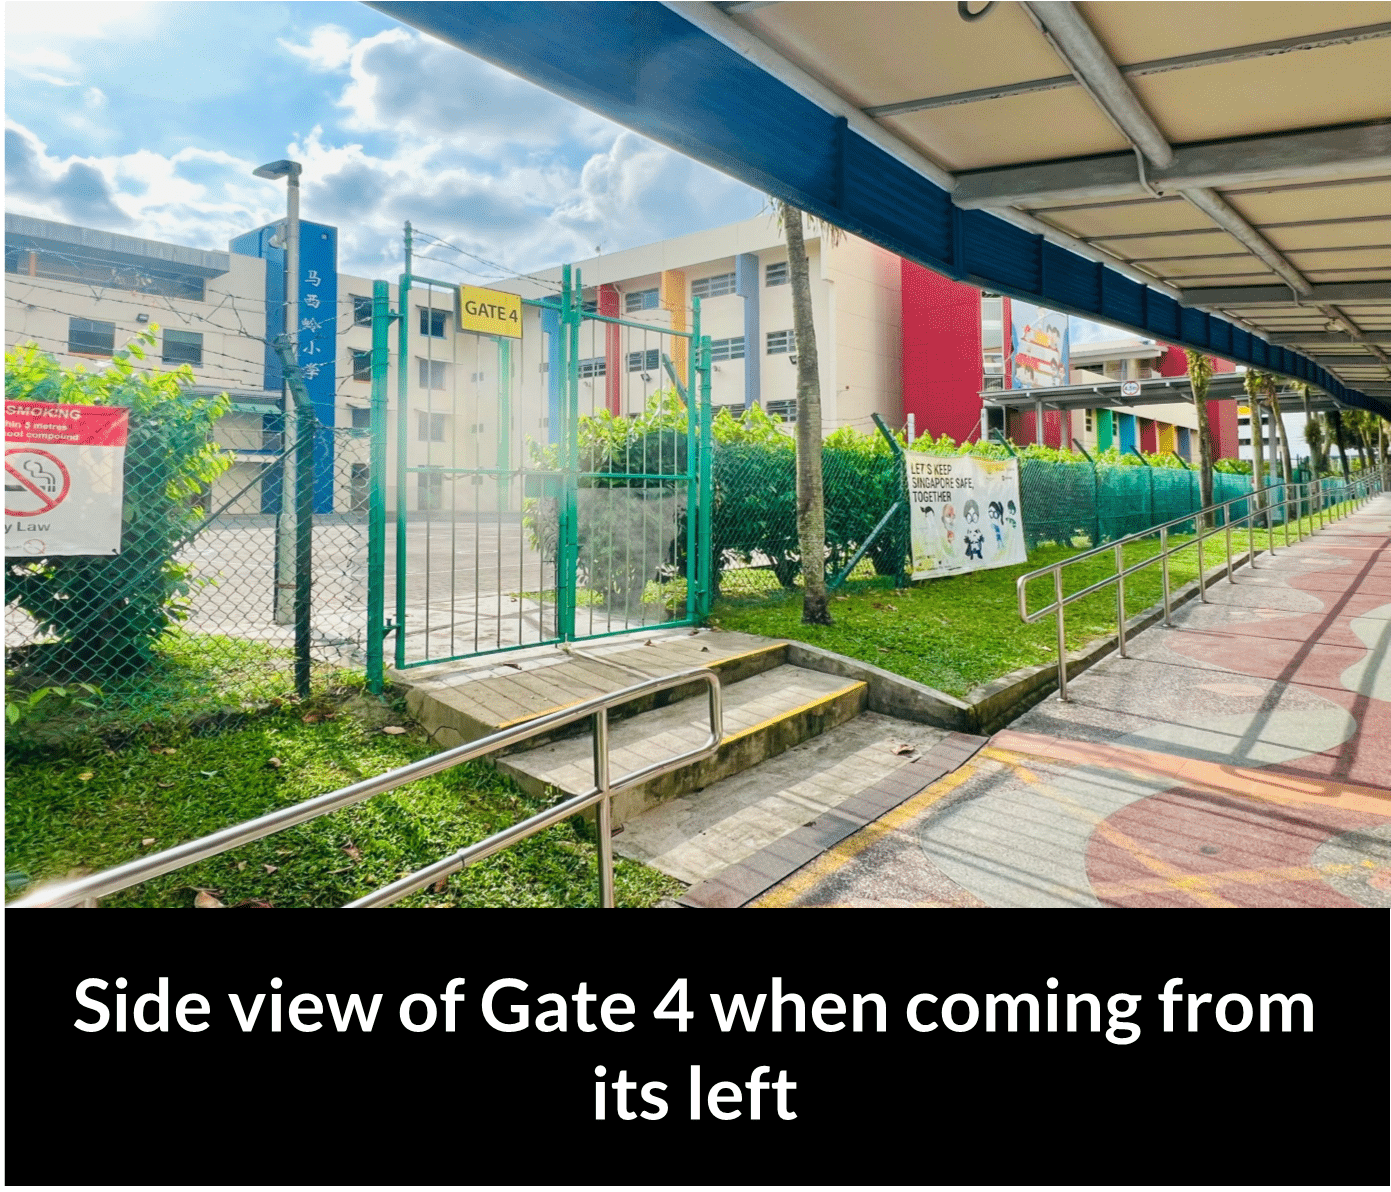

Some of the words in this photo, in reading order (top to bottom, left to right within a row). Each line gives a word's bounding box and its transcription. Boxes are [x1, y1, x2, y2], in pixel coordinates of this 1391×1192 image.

[465, 300, 507, 321] GATE
[509, 309, 519, 323] 4
[934, 464, 952, 476] KEEP
[912, 477, 955, 489] SINGAPORE
[912, 491, 952, 503] TOGETHER
[17, 521, 51, 532] Law
